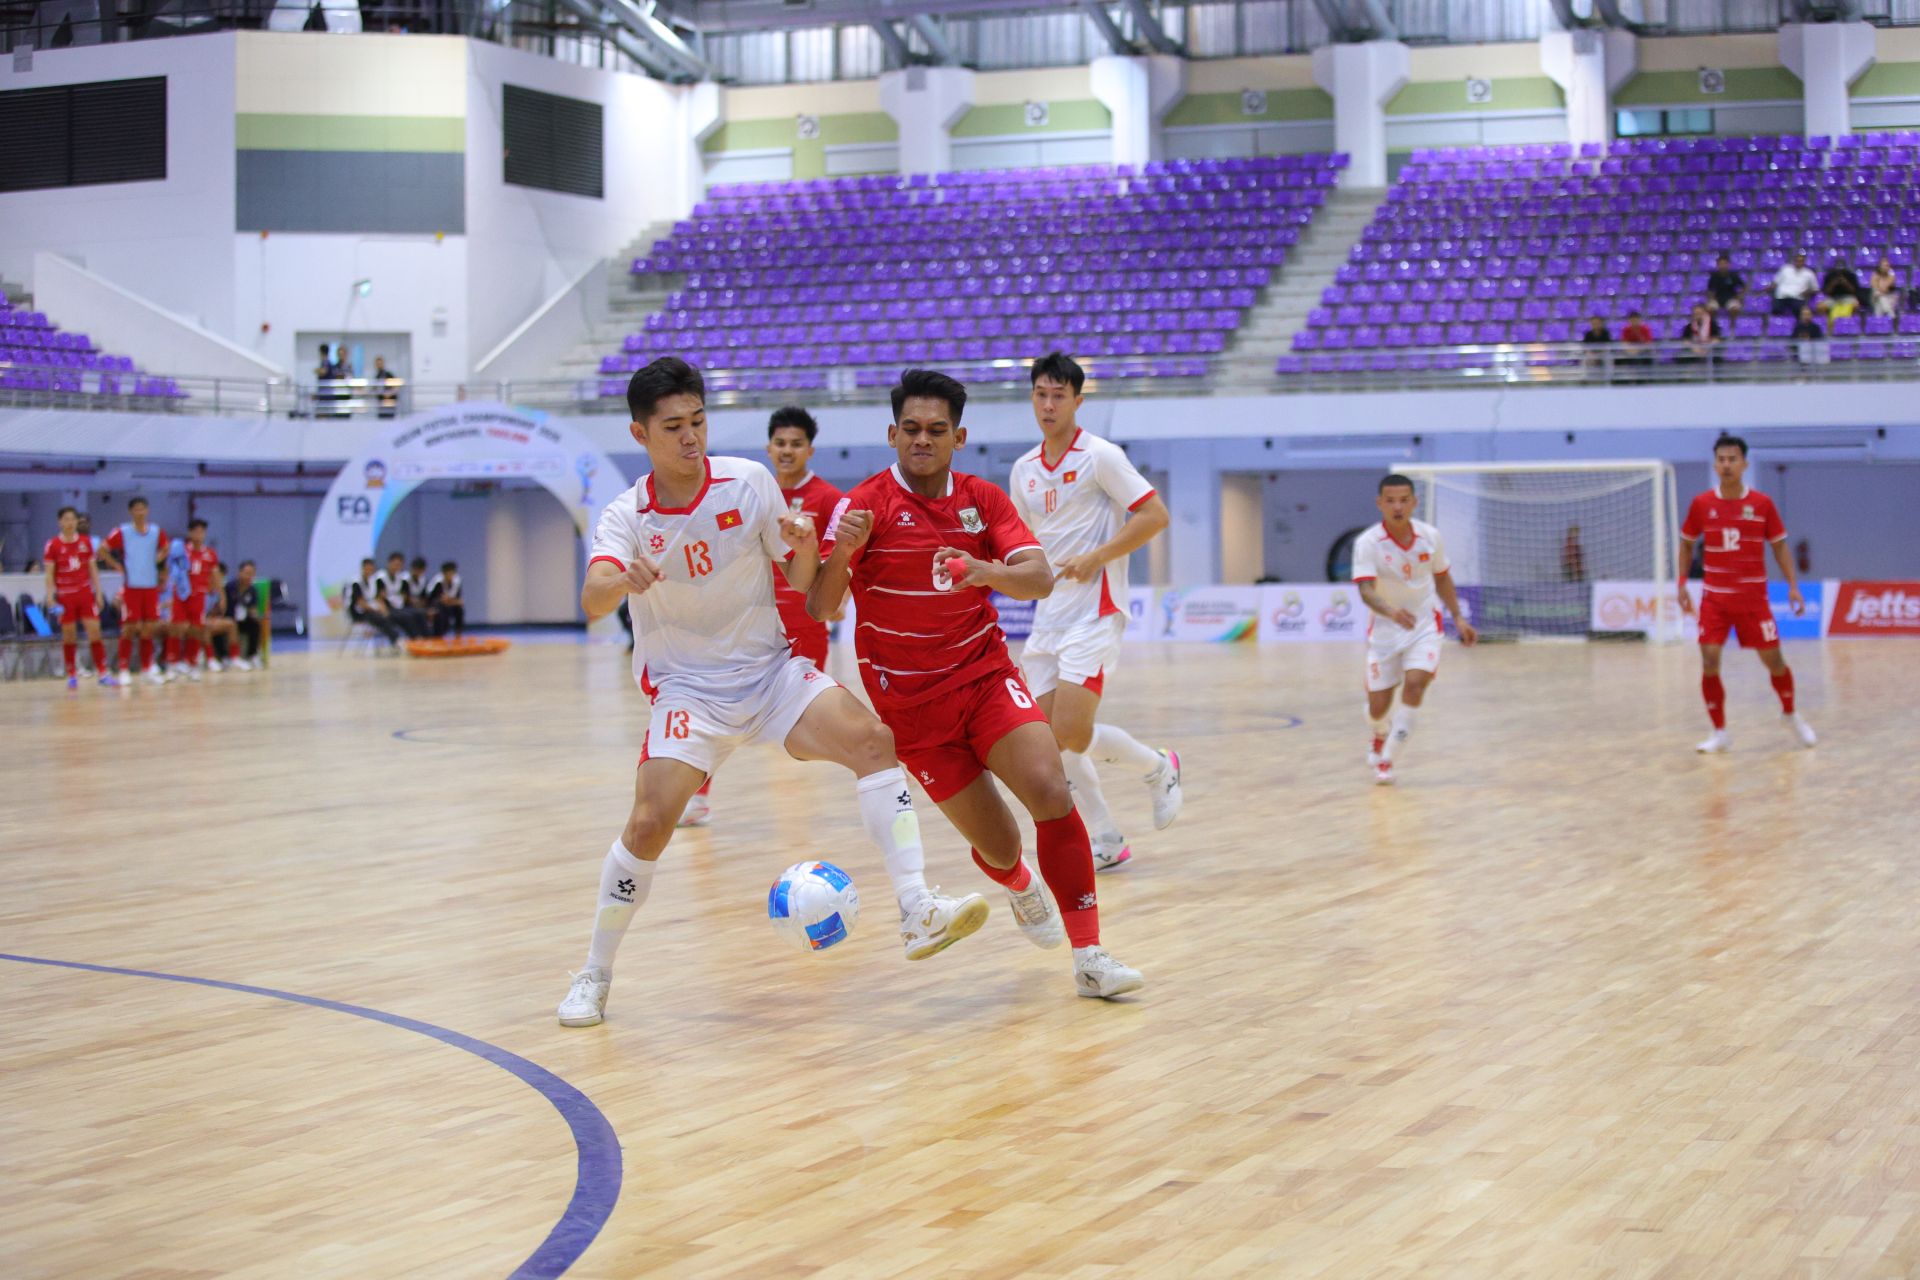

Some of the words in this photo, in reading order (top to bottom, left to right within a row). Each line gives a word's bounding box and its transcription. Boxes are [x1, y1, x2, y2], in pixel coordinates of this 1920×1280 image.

[1045, 488, 1057, 513] 10
[1722, 528, 1741, 551] 12
[684, 540, 713, 578] 13
[1845, 589, 1920, 624] jetts
[1761, 620, 1778, 642] 12
[1005, 678, 1032, 709] 6
[664, 710, 690, 739] 13
